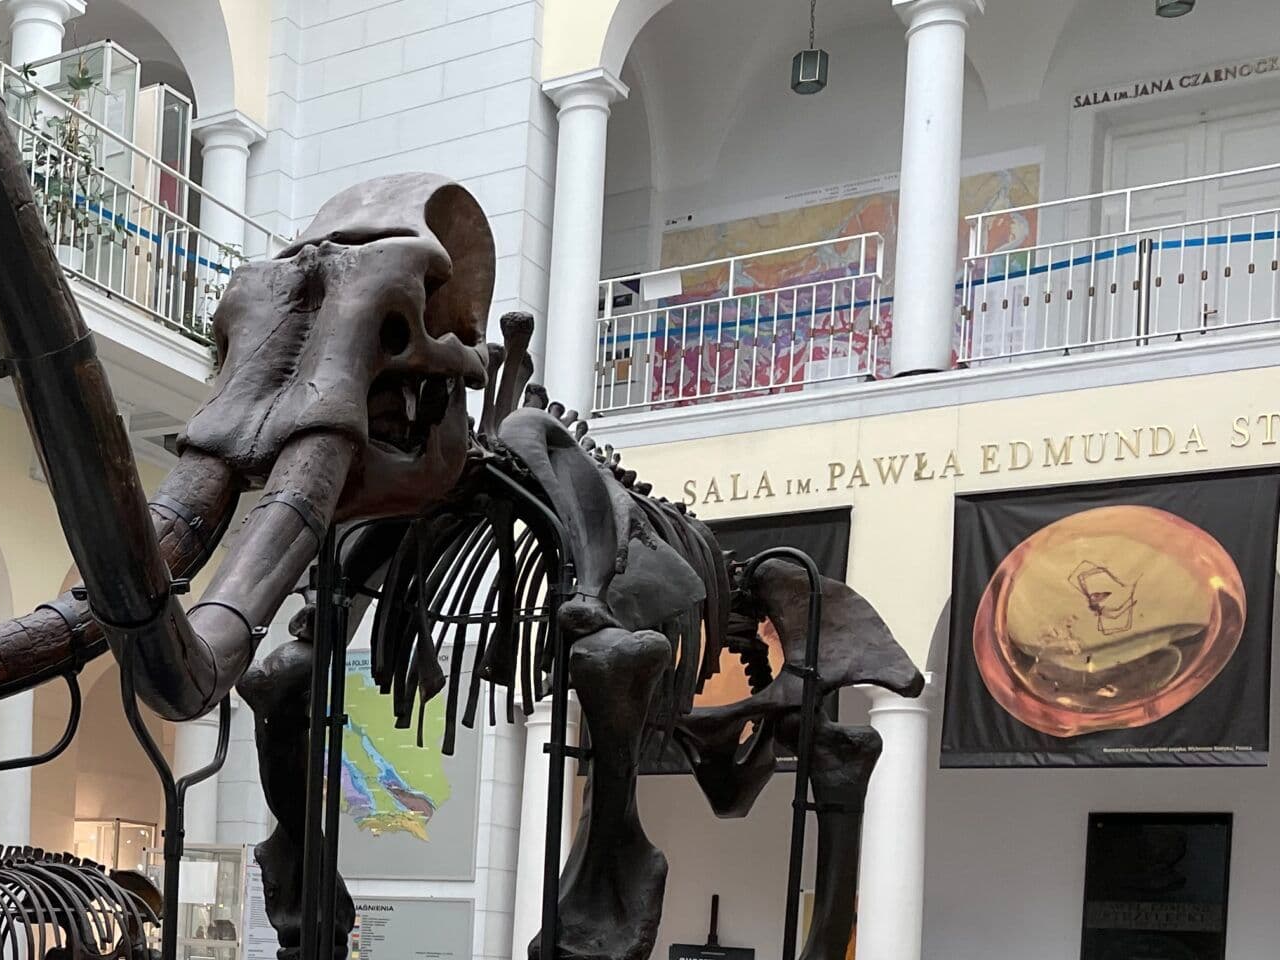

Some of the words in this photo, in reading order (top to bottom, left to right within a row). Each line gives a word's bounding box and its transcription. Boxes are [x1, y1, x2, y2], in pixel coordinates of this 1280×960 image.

[1073, 91, 1111, 108] SALA
[1131, 78, 1175, 98] JANA
[682, 470, 776, 507] SALA
[786, 478, 820, 495] IM.
[827, 449, 965, 491] PAWŁA
[980, 423, 1209, 475] EDMUNDA
[355, 904, 394, 912] JAŚNIENIA
